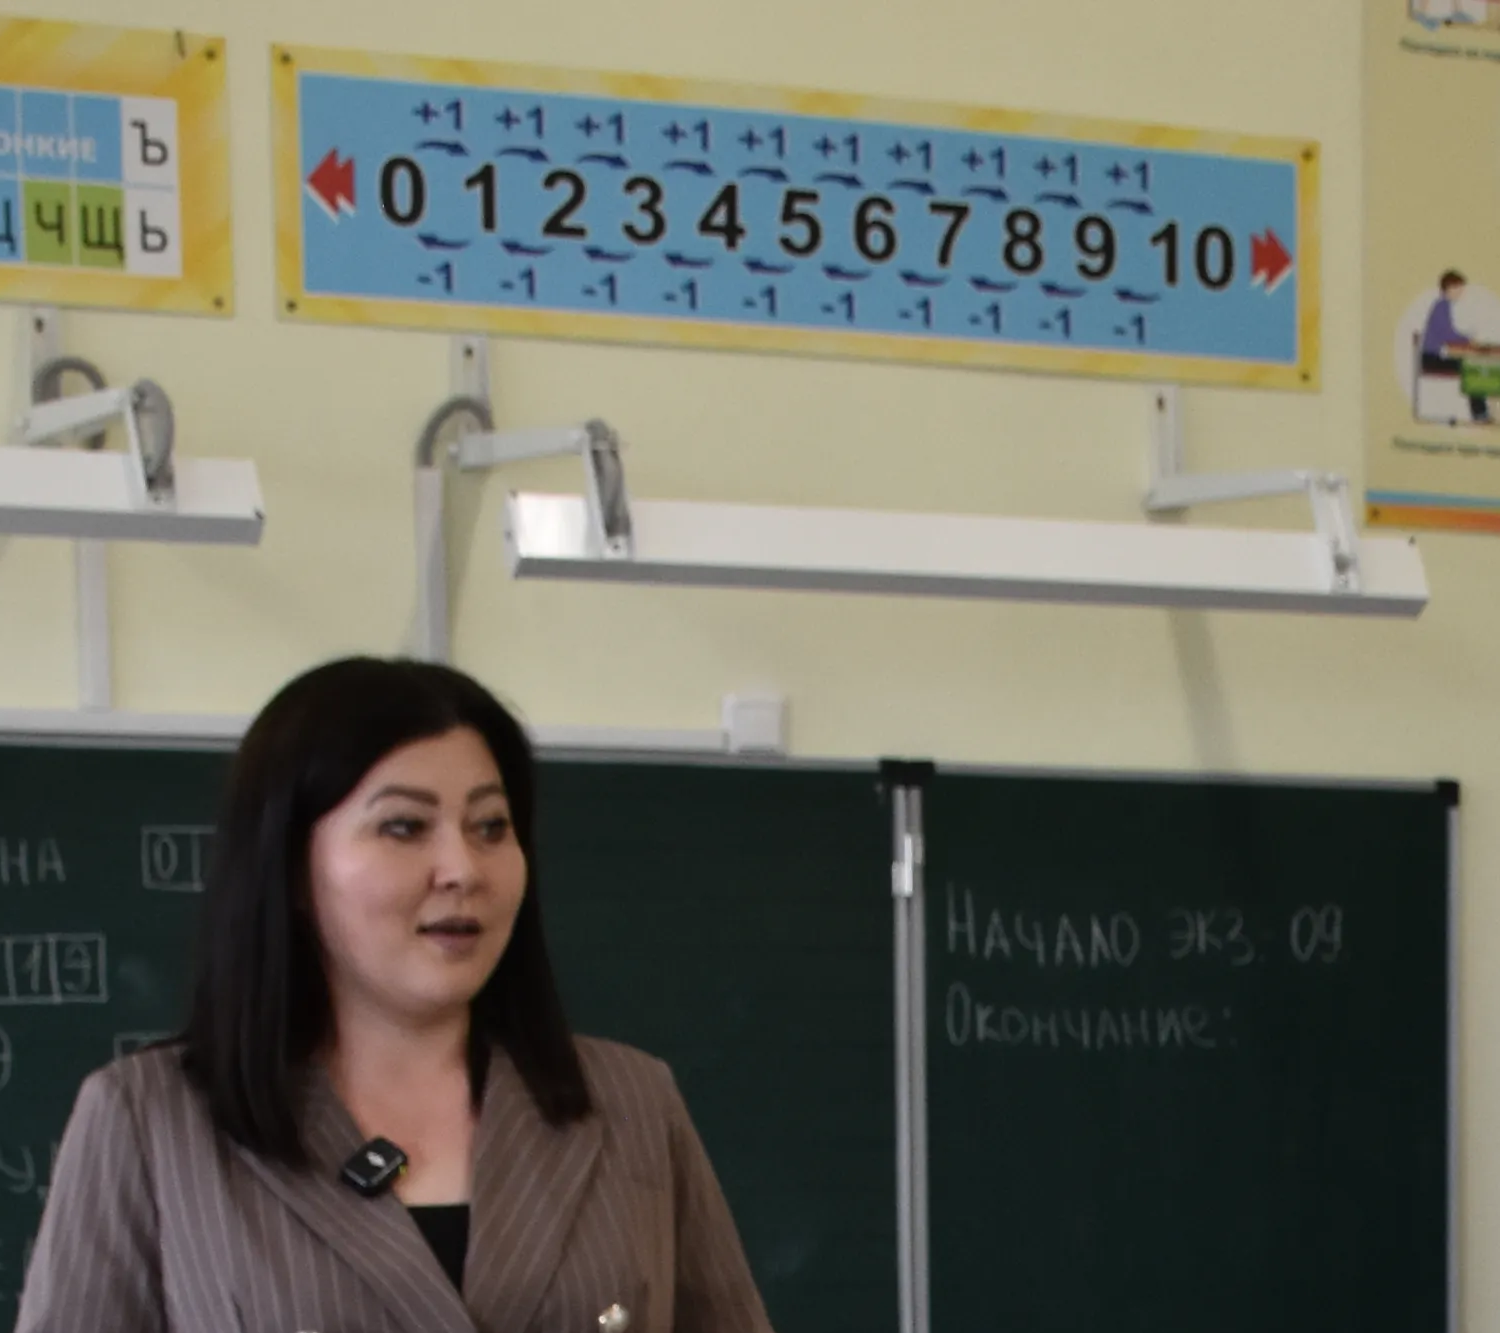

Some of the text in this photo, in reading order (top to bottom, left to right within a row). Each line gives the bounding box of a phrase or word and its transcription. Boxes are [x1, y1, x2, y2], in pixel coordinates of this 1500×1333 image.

[379, 155, 1236, 292] 0 1 2 3 4 5 6 7 8 9 10
